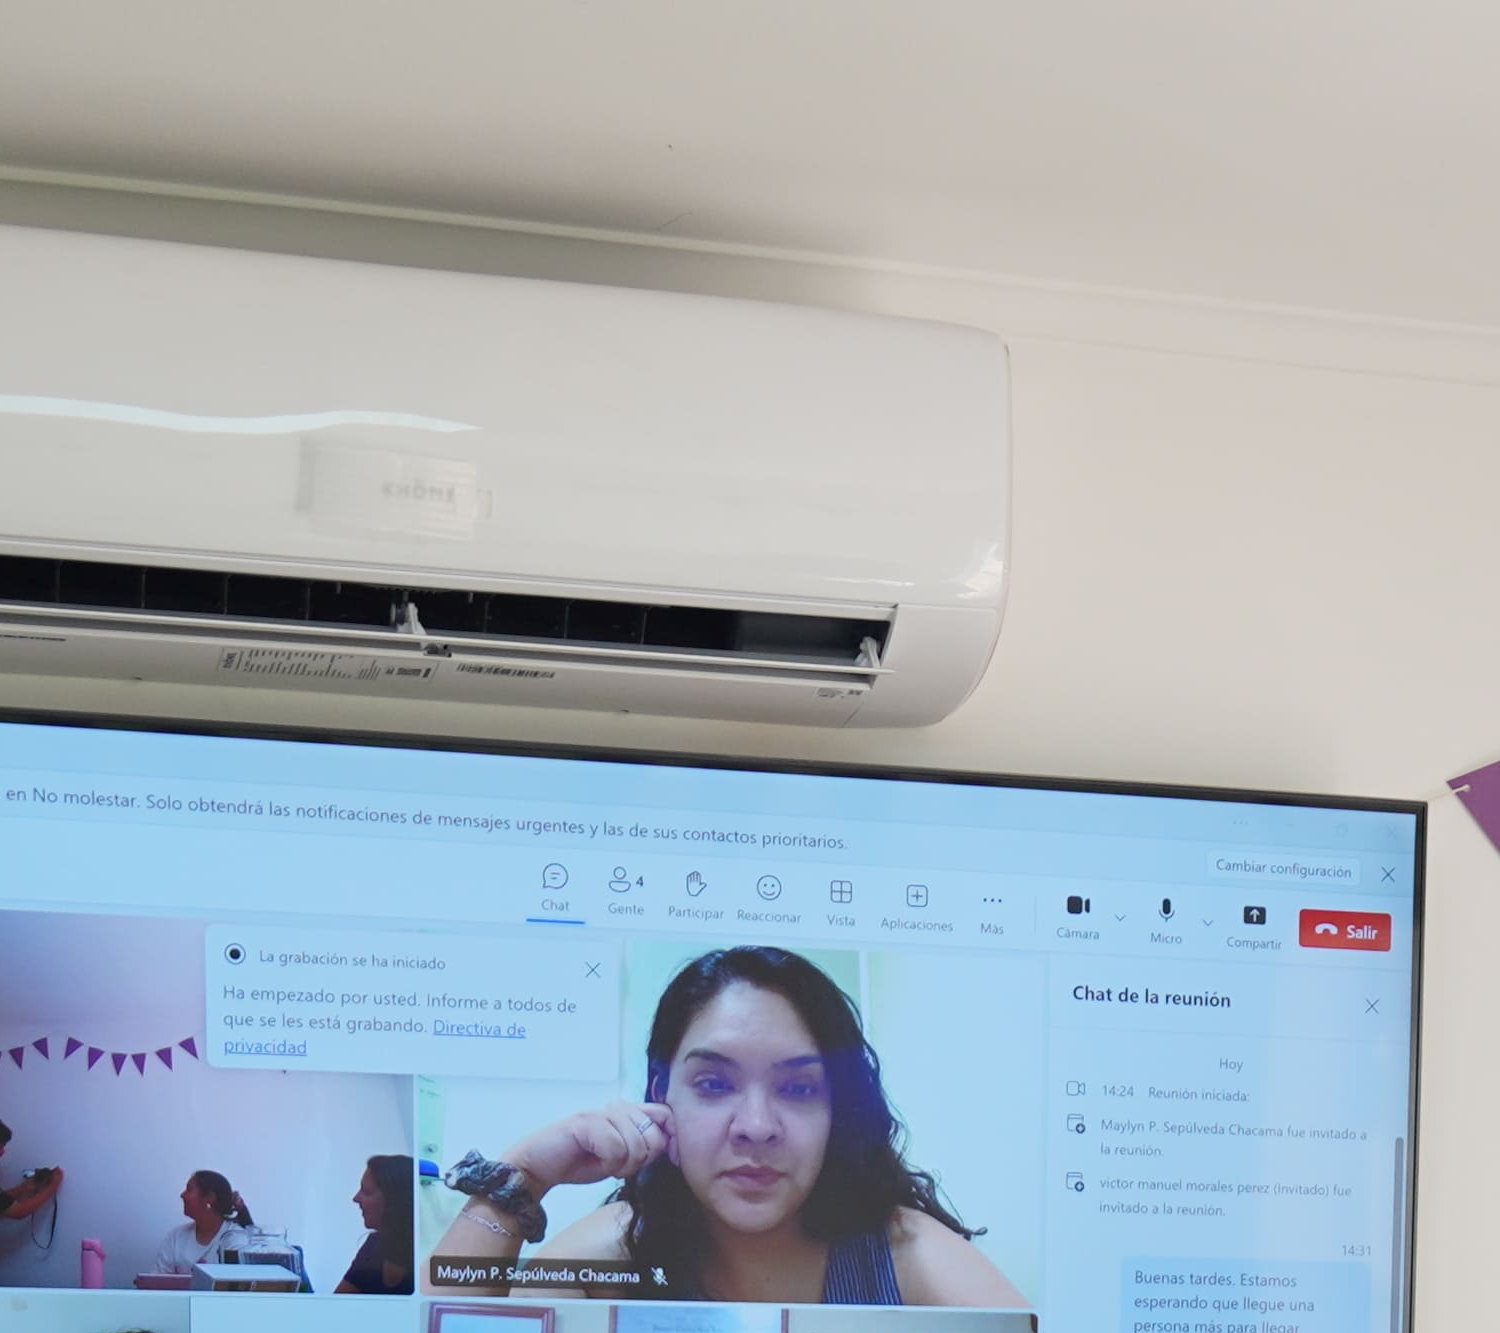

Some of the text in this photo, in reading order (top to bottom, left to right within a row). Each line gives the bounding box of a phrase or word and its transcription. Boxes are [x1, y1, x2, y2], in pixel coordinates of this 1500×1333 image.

[6, 789, 27, 801] en
[33, 788, 58, 803] No
[64, 790, 140, 808] molestar.
[146, 794, 182, 811] Solo
[188, 798, 263, 815] obtendrá
[268, 801, 290, 817] las
[296, 805, 407, 824] notificaciones
[412, 810, 432, 825] de
[438, 814, 511, 832] mensajes
[517, 819, 585, 835] urgentes
[589, 824, 599, 837] y
[603, 822, 624, 837] las
[629, 823, 649, 838] de
[653, 827, 677, 840] sus
[683, 827, 757, 844] contactos
[762, 831, 848, 851] prioritarios.
[1216, 859, 1352, 880] Cambiar configuración
[636, 876, 643, 887] 4
[541, 899, 569, 912] Chat
[608, 903, 644, 917] Gente
[668, 906, 724, 921] Participar
[737, 909, 801, 923] Reaccionar
[827, 915, 855, 927] Vista
[881, 917, 953, 933] Aplicaciones
[980, 922, 1004, 935] Más
[1056, 927, 1100, 941] Cámara
[1150, 932, 1182, 945] Micro
[1346, 924, 1378, 942] Salir
[1226, 937, 1282, 951] Compartir
[260, 951, 446, 970] La grabación se ha iniciado
[224, 986, 576, 1013] Ha empezado por usted. Informe a todos de
[1073, 986, 1231, 1008] Chat de la reunión
[224, 1012, 526, 1038] que se les está grabando. Directiva de
[224, 1039, 307, 1056] privacidad
[1342, 1245, 1371, 1256] 14:31
[438, 1266, 639, 1283] Maylyn P. Sepúlveda Chacama
[1135, 1270, 1296, 1288] Buenas tardes. Estamos
[1134, 1296, 1314, 1314] esperando que llegue una
[1194, 1319, 1222, 1333] más
